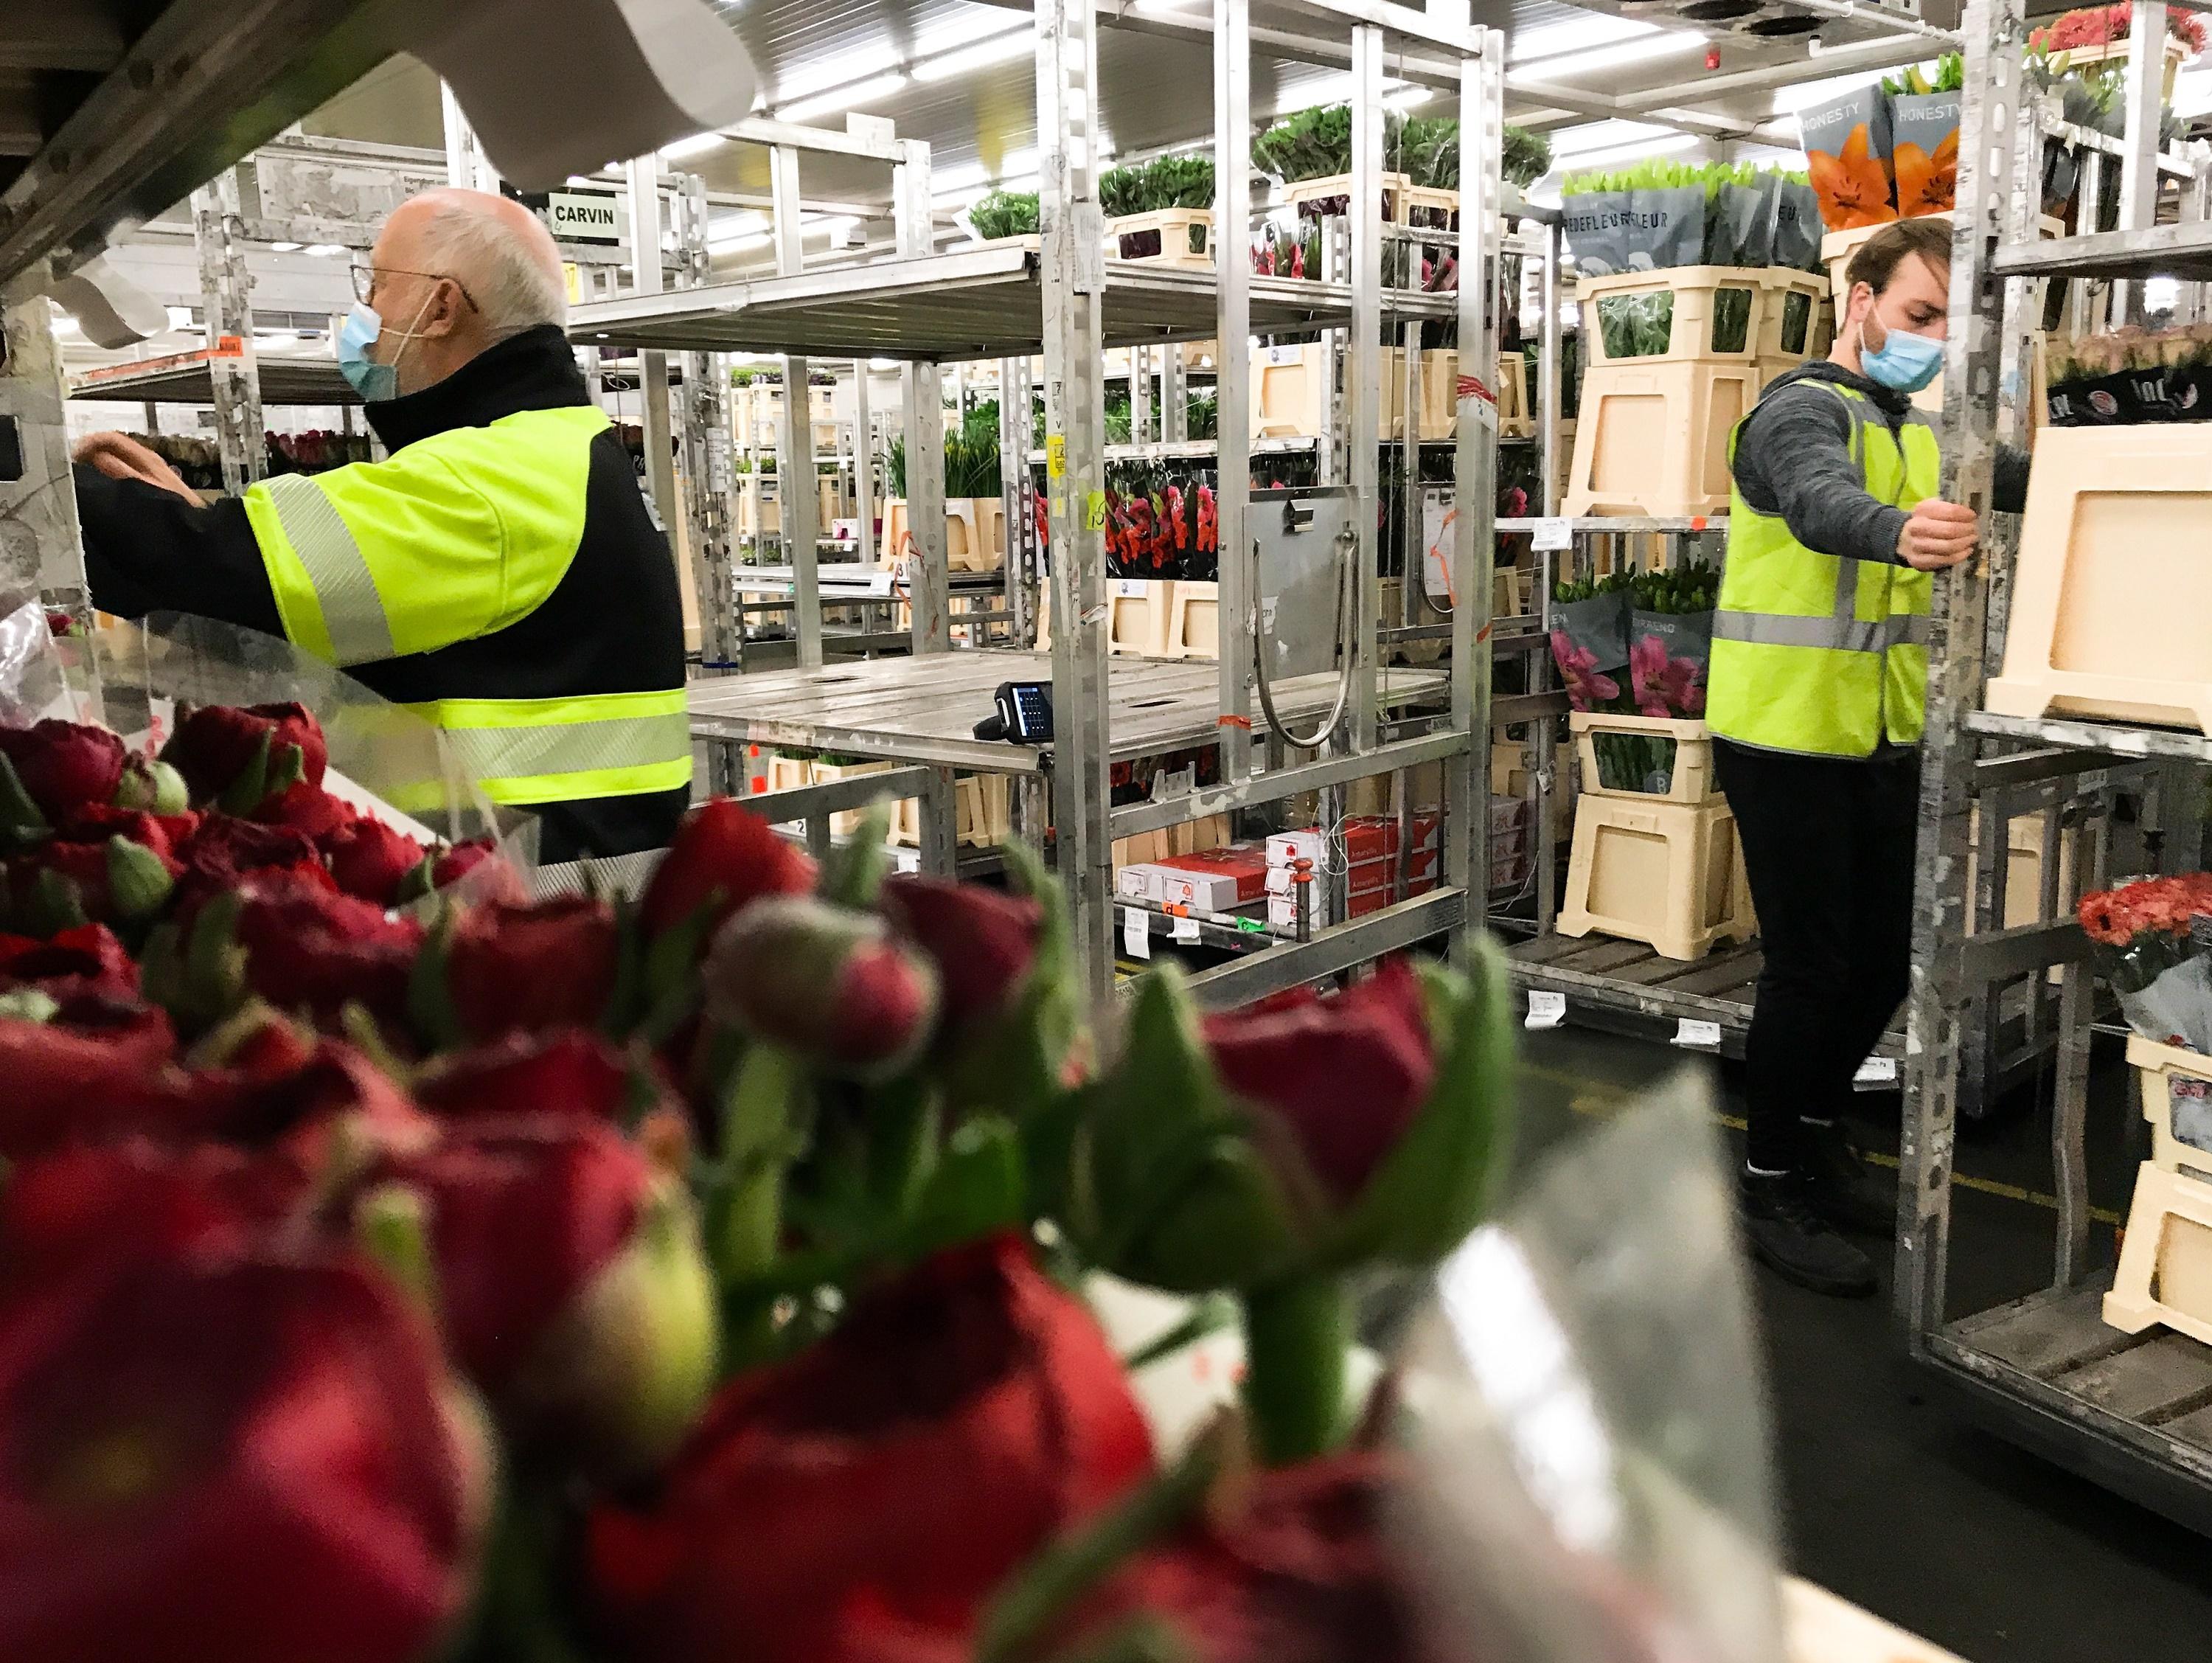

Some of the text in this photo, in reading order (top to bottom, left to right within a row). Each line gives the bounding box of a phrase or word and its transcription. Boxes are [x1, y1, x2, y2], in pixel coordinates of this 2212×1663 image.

[1801, 102, 1860, 133] HONESTY
[555, 206, 613, 224] CARVIN
[797, 820, 805, 834] 2
[1166, 903, 1173, 915] d
